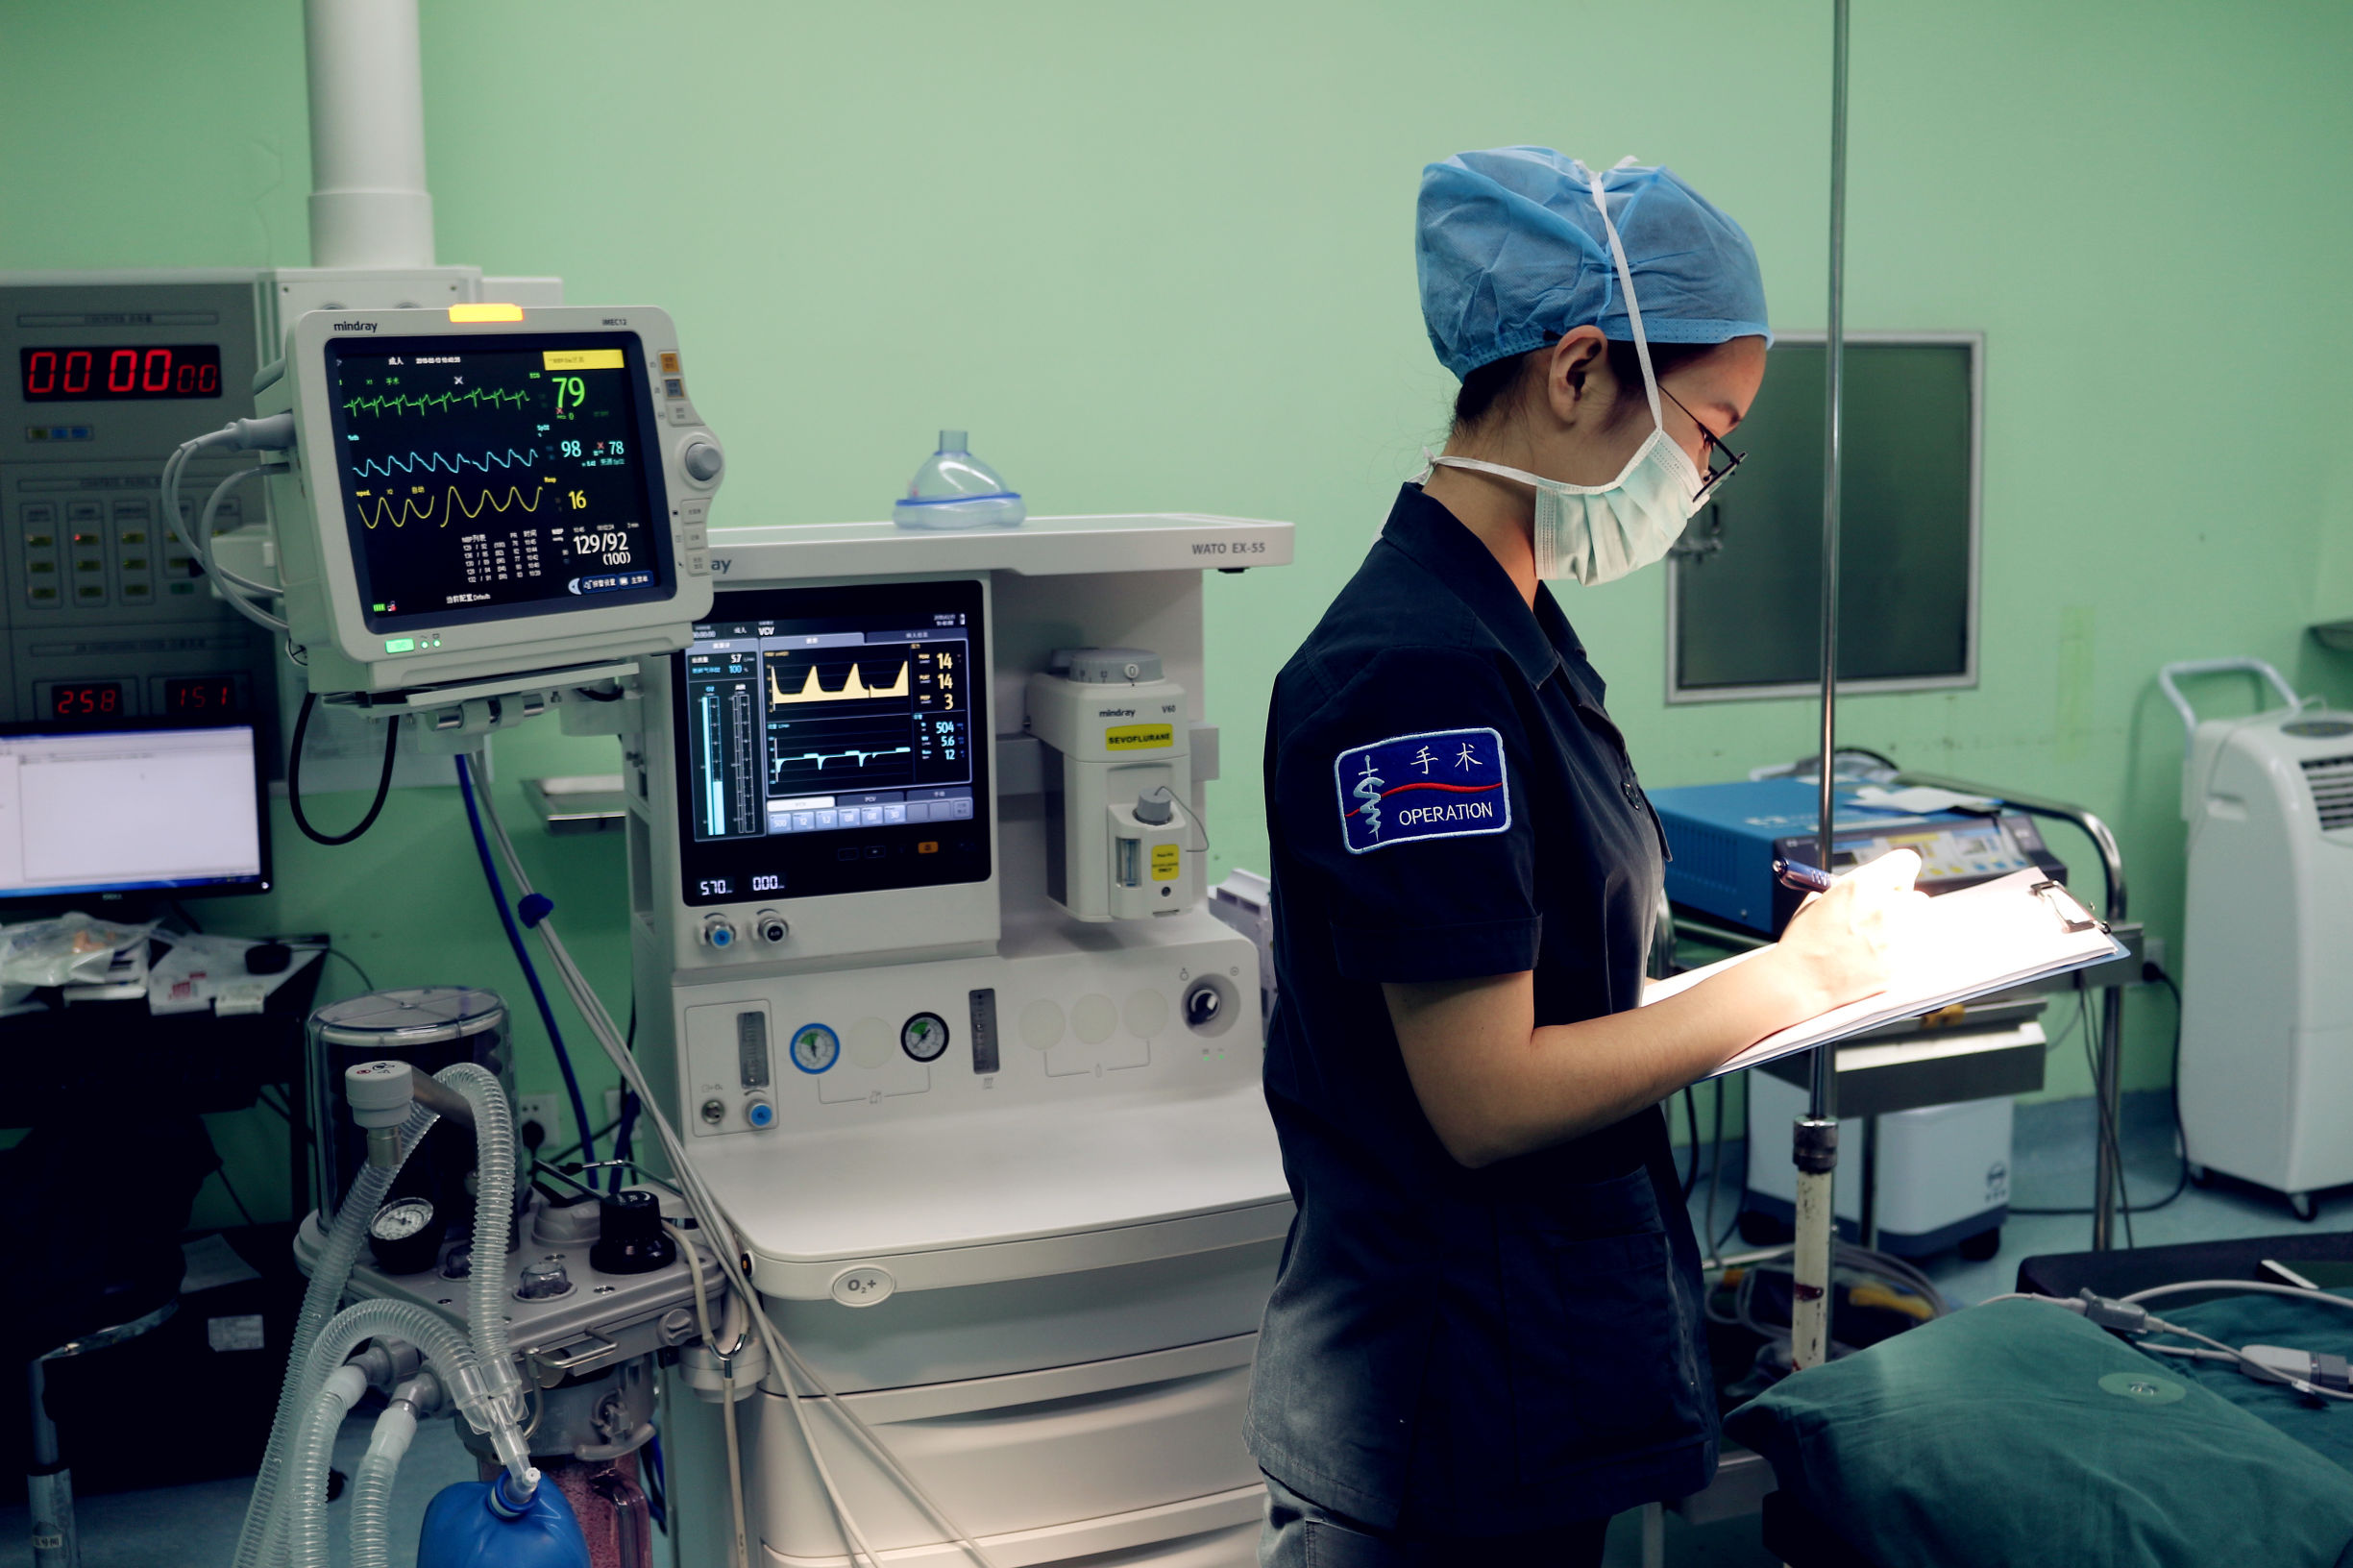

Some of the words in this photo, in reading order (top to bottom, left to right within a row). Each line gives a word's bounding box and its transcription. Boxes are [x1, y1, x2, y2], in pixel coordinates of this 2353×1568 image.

[333, 321, 378, 332] mindray
[551, 377, 585, 408] 79
[560, 440, 582, 457] 98
[608, 440, 625, 455] 78
[569, 490, 587, 509] 16
[573, 532, 629, 555] 129/92
[1191, 544, 1226, 554] WATO
[1232, 543, 1265, 553] EX-55
[602, 551, 631, 565] (100)
[758, 626, 774, 636] VCV
[936, 652, 953, 670] 14
[728, 665, 742, 674] 100
[937, 674, 953, 690] 14
[57, 690, 116, 714] 258
[944, 694, 954, 710] 3
[1162, 704, 1176, 713] V60
[1099, 708, 1136, 718] mindray
[936, 722, 955, 734] 504
[941, 736, 955, 747] 5.6
[1108, 732, 1170, 745] SEVOFLURANE
[944, 749, 956, 760] 12
[1409, 743, 1483, 774] 手术
[1398, 802, 1494, 826] OPERATION
